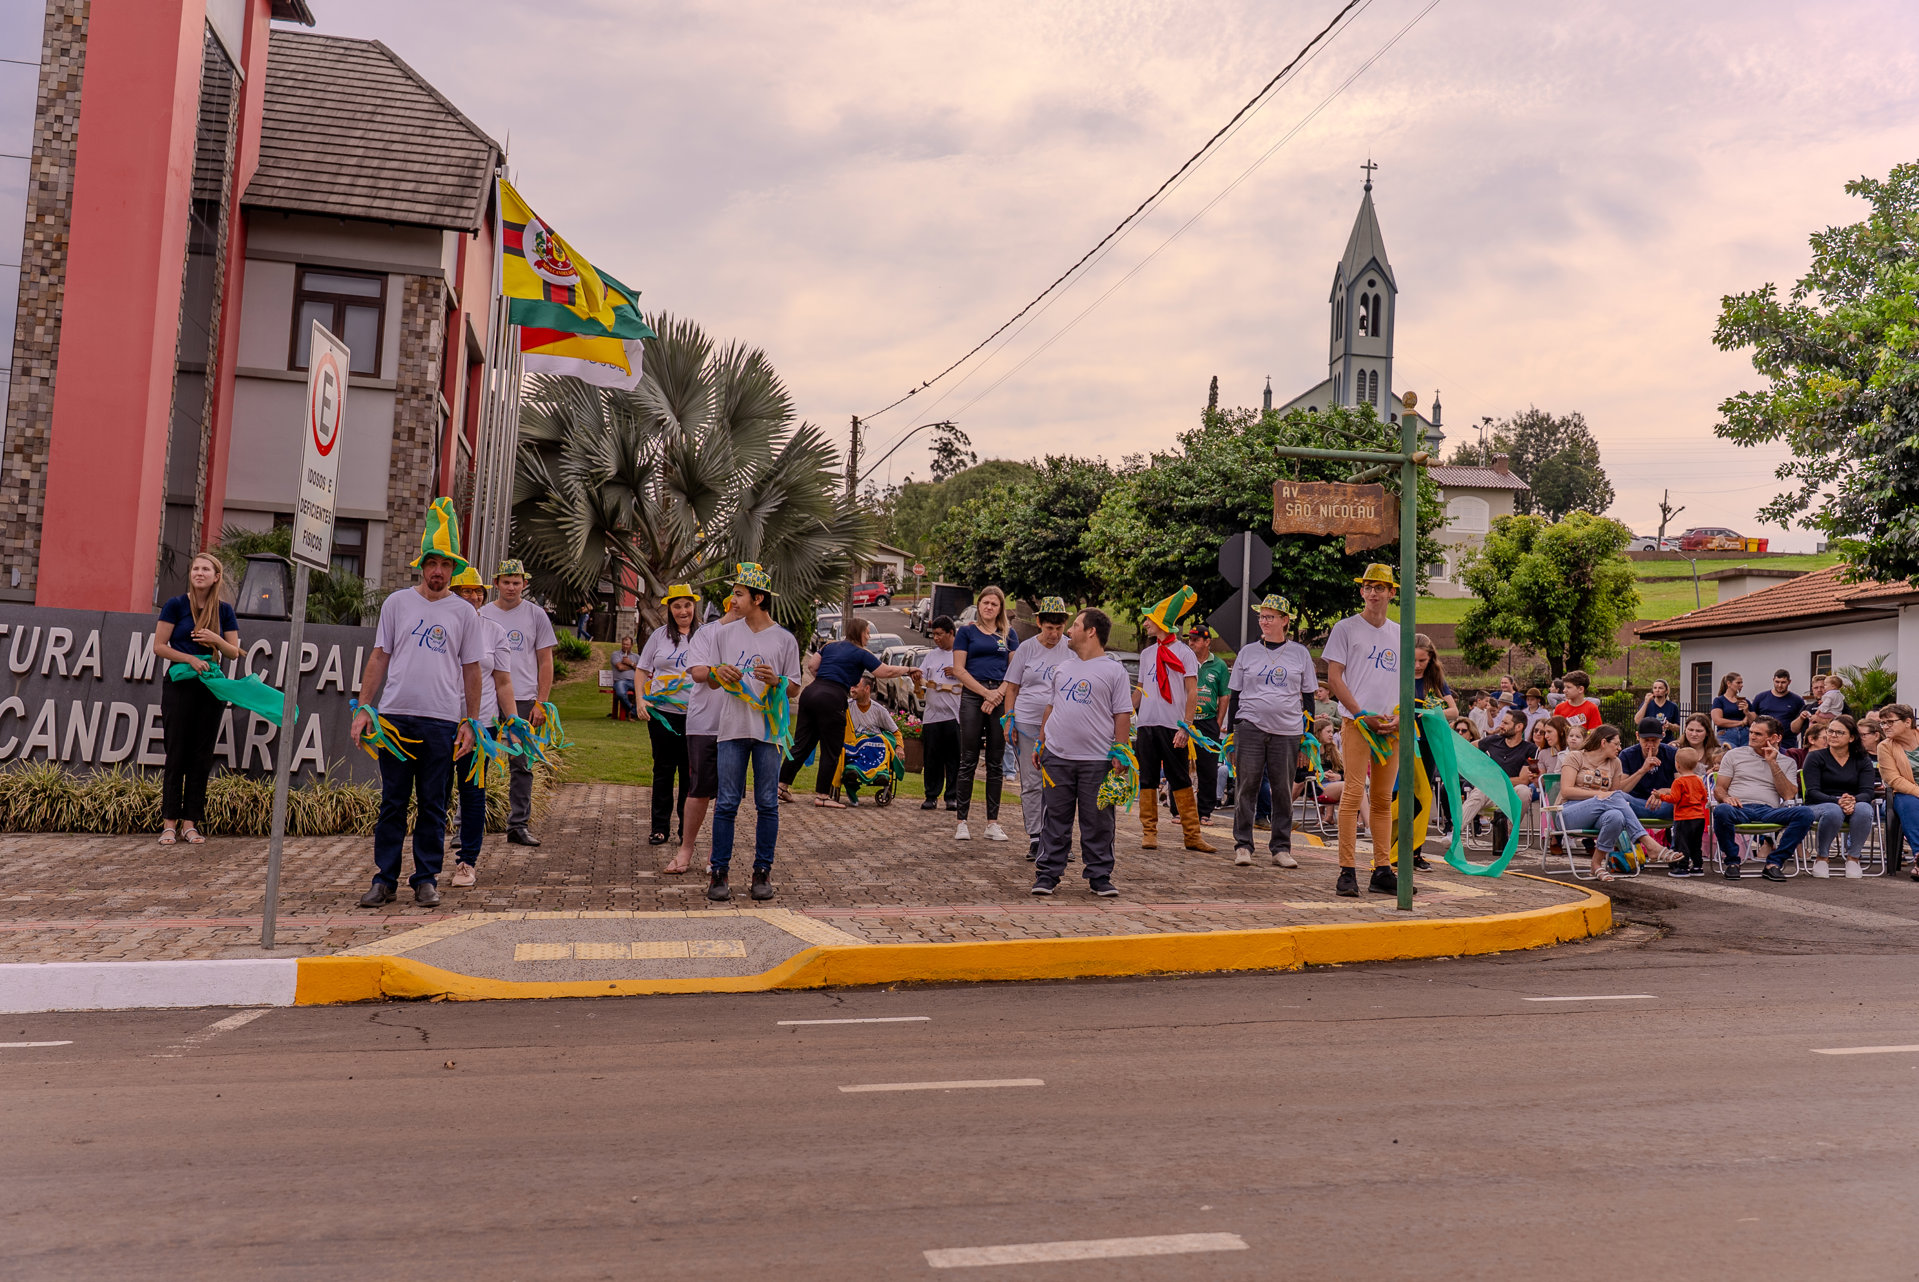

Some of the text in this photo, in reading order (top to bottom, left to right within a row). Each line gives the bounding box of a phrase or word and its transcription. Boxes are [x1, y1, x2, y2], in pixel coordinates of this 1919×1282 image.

[320, 370, 333, 437] E
[308, 467, 333, 494] IDOSOS E
[1282, 486, 1299, 498] AV
[300, 497, 332, 525] DEFICIENTES
[1320, 503, 1375, 519] NICOLAU
[0, 624, 102, 677] URA
